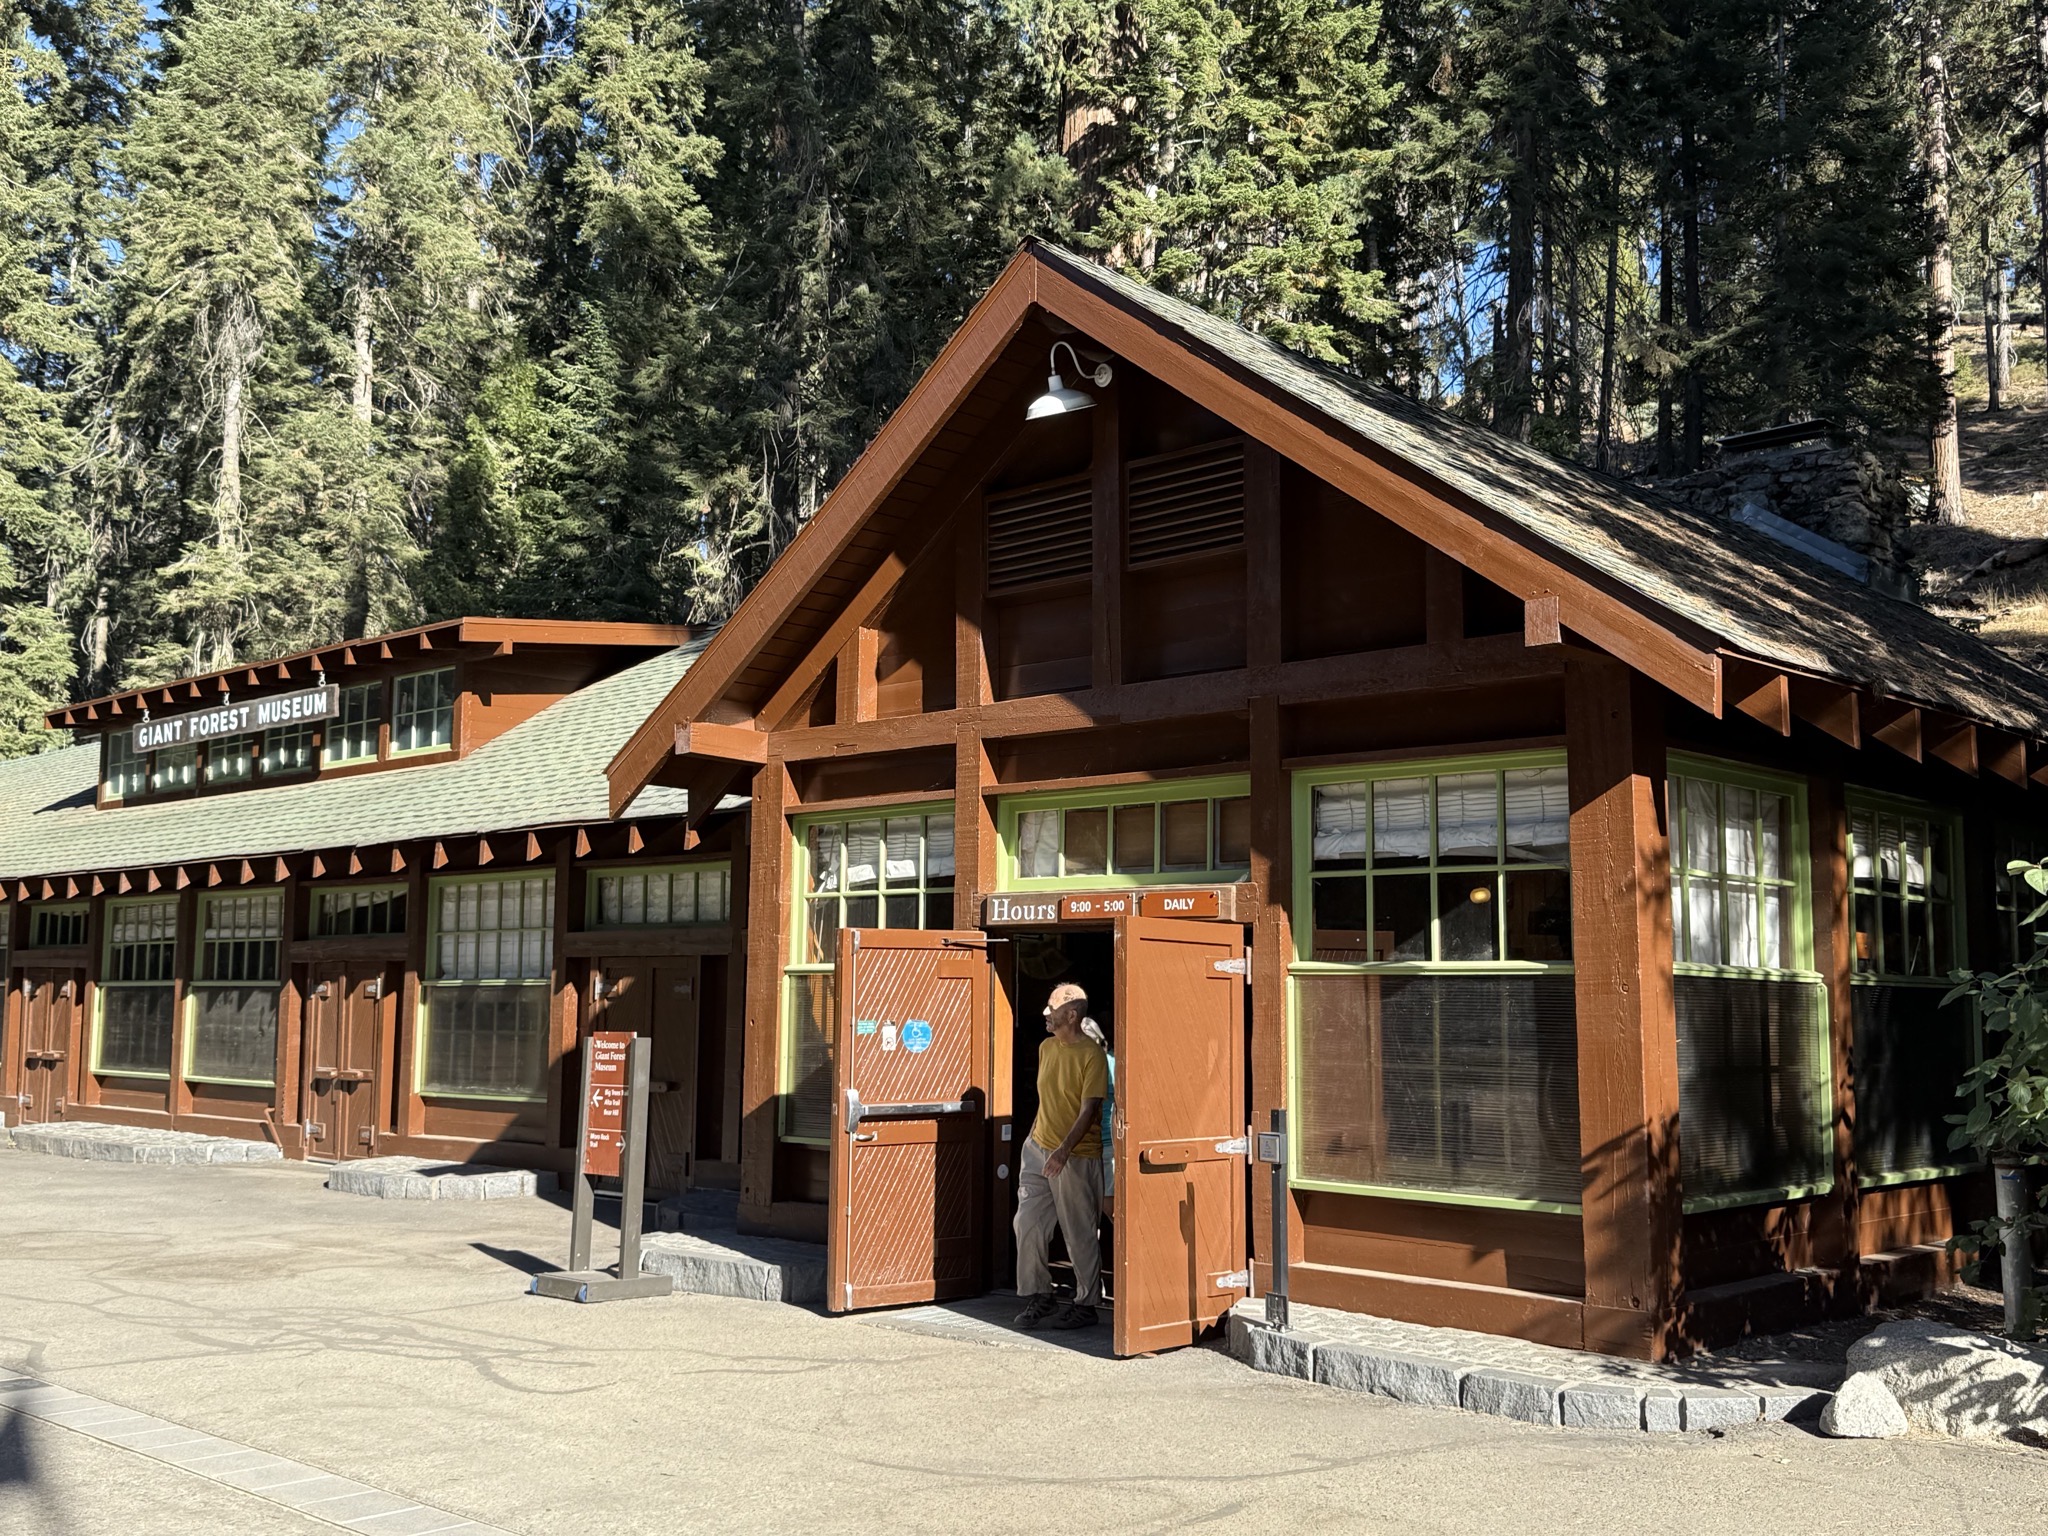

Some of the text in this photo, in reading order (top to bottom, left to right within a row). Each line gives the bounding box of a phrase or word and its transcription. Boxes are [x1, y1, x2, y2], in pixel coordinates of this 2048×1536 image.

[138, 691, 327, 748] GIANT FOREST MUSEUM
[991, 898, 1056, 921] Hours
[1070, 900, 1091, 913] 9:00
[1103, 899, 1125, 912] 5:00
[1164, 898, 1195, 911] DAILY
[594, 1039, 626, 1050] Welcome to
[595, 1051, 626, 1061] Giant Forest
[594, 1062, 617, 1071] Museum
